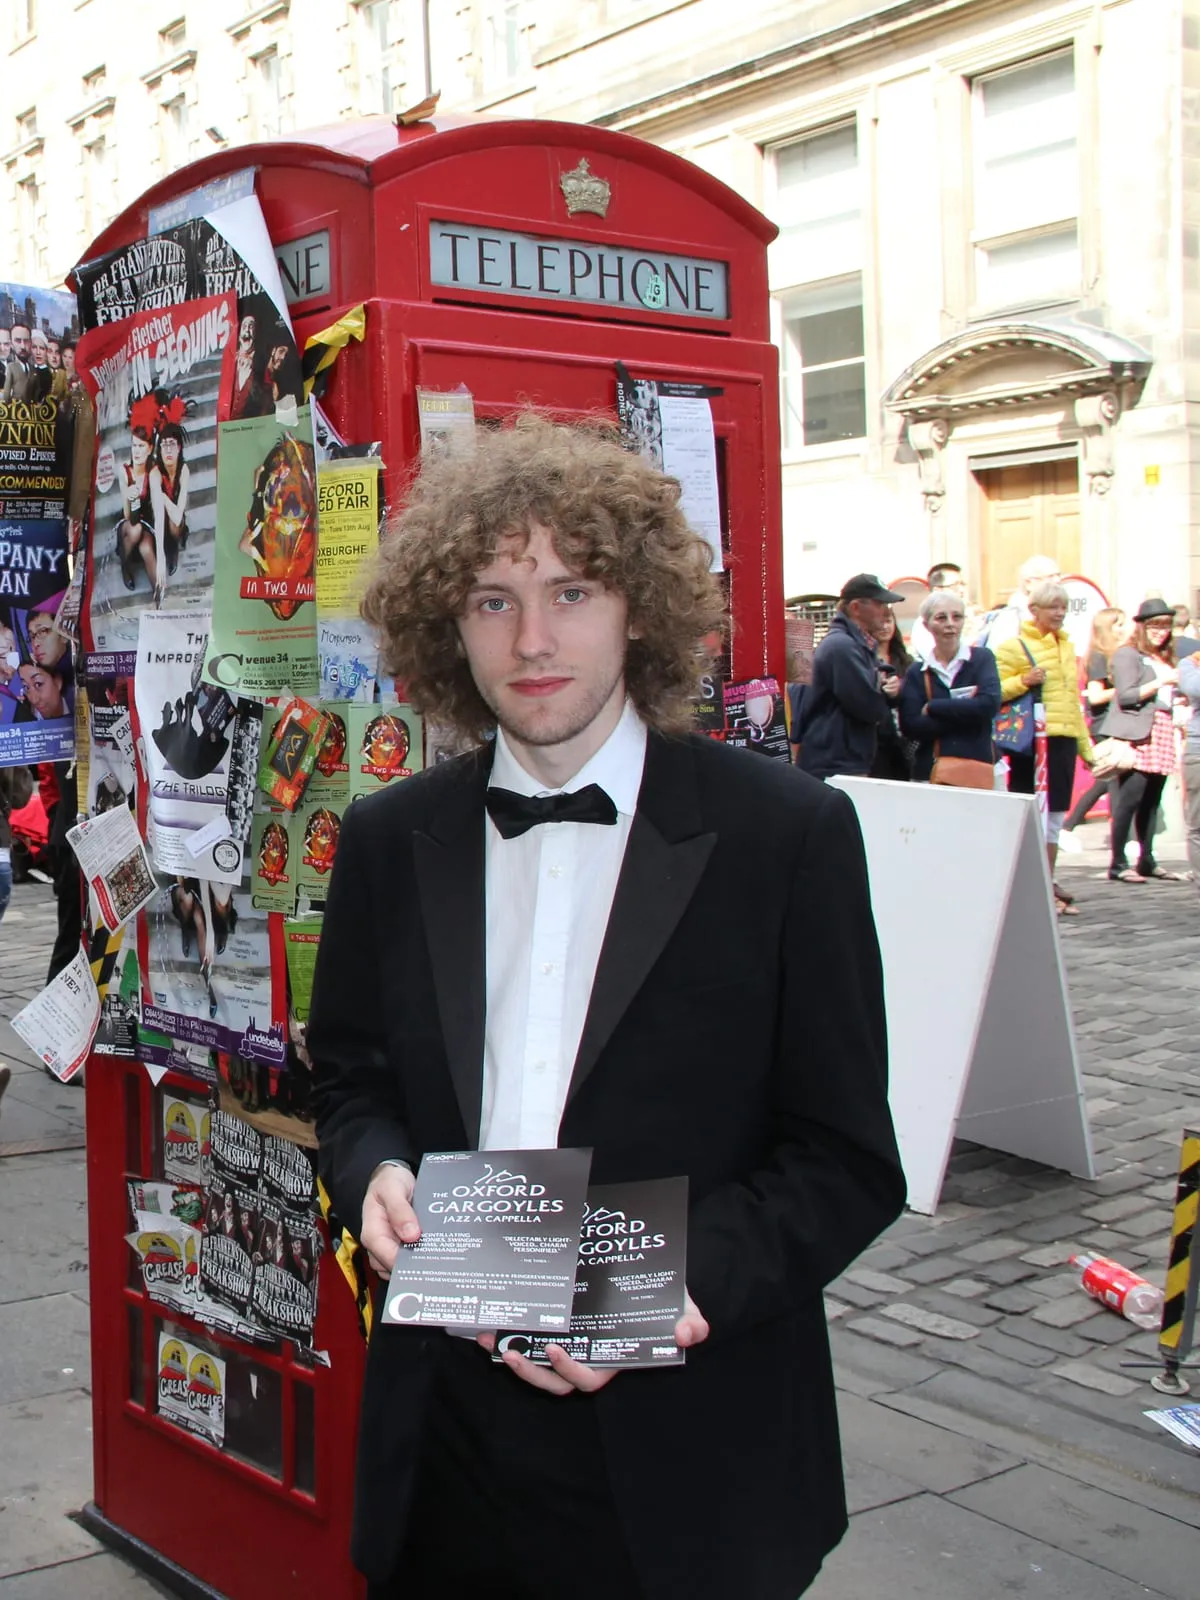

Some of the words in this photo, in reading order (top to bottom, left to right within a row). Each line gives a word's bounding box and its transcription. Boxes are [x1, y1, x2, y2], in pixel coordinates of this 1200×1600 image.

[440, 232, 714, 312] TELEPHONE
[131, 312, 174, 352] Fletcher
[131, 351, 153, 398] IN
[154, 300, 230, 385] SEQUINS
[617, 382, 628, 422] RODNEY
[318, 482, 364, 499] ECORD
[337, 495, 370, 510] FAIR
[357, 524, 371, 533] Aug
[263, 582, 289, 596] TWO
[245, 655, 276, 665] venue
[276, 652, 289, 663] 34
[10, 727, 22, 738] 34
[153, 779, 180, 793] THE
[60, 972, 81, 996] NET
[164, 1141, 199, 1162] GREASE
[210, 1134, 261, 1170] FREAKSHOW
[451, 1184, 546, 1198] OXFORD
[428, 1199, 565, 1214] GARGOYLES
[442, 1215, 471, 1224] JAZZ
[473, 1215, 483, 1223] A
[485, 1215, 542, 1223] CAPPELLA
[578, 1234, 665, 1255] GOYLES
[588, 1253, 645, 1265] CAPPELLA
[145, 1262, 184, 1283] GREASE
[201, 1256, 252, 1297] FREAKSHOW
[253, 1286, 313, 1326] FREAKSHOW
[423, 1295, 462, 1303] venue
[462, 1295, 479, 1304] 34
[533, 1336, 572, 1344] venue
